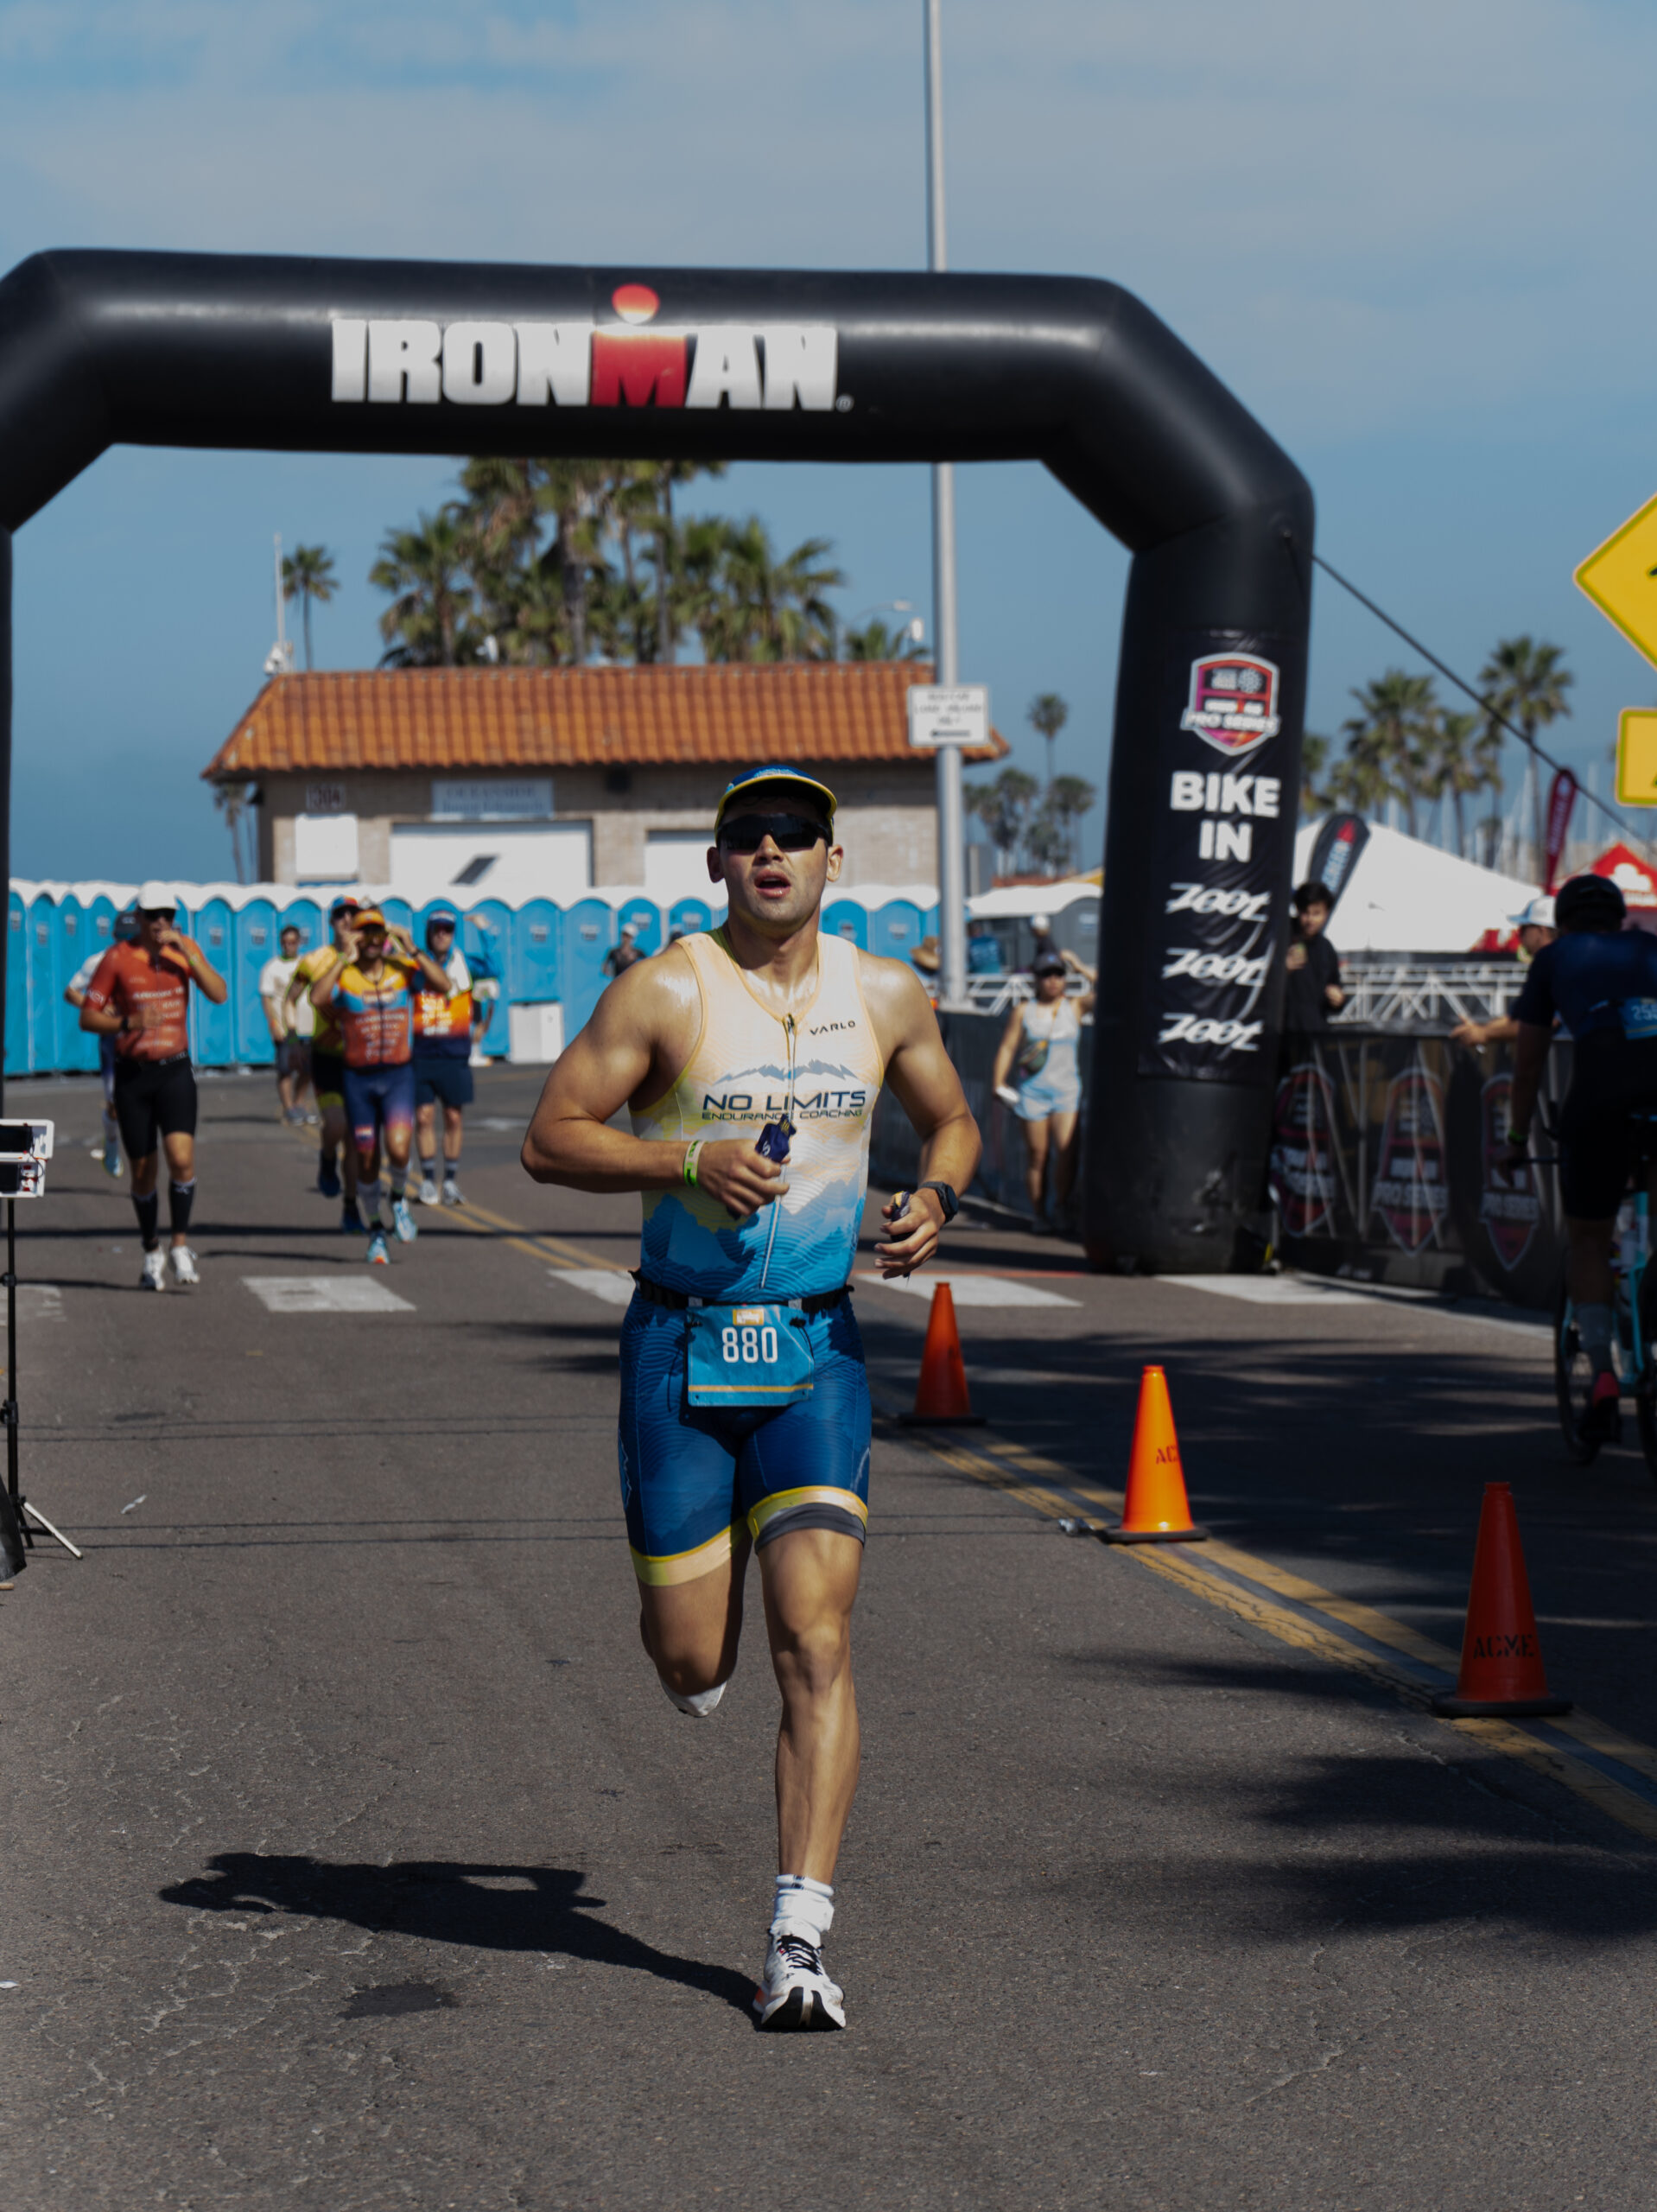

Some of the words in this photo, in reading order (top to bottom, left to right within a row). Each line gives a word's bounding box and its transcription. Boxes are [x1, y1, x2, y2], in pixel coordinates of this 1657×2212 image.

[332, 318, 837, 410] IRONMAN
[1171, 772, 1280, 817] BIKE
[1199, 821, 1252, 862] IN
[809, 1020, 855, 1035] VARLO
[703, 1094, 752, 1110] NO
[765, 1090, 866, 1110] LIMITS
[799, 1109, 862, 1120] COACHING
[722, 1326, 778, 1363] 880
[1473, 1634, 1535, 1659] ACME
